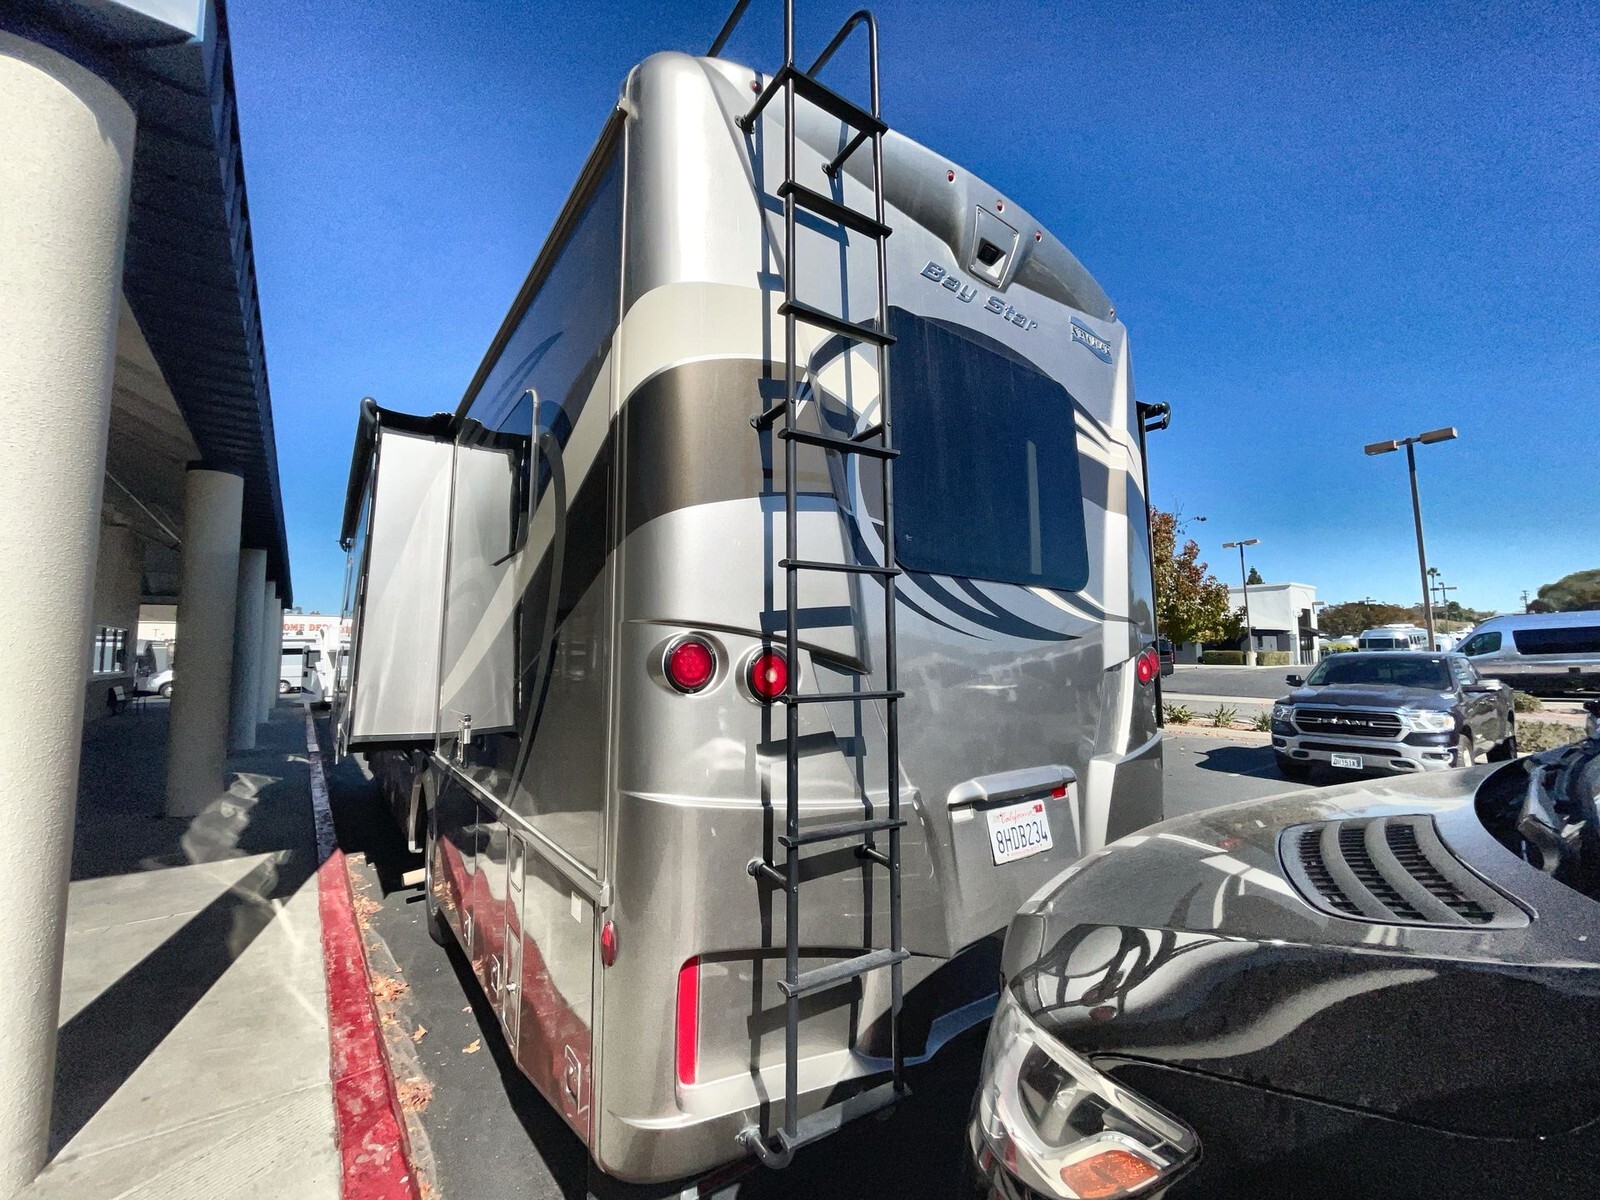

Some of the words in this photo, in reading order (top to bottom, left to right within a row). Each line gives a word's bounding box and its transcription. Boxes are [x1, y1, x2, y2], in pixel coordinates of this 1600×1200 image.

[920, 261, 978, 303] Bay
[984, 295, 1038, 331] Star
[996, 819, 1048, 854] 8HDB234
